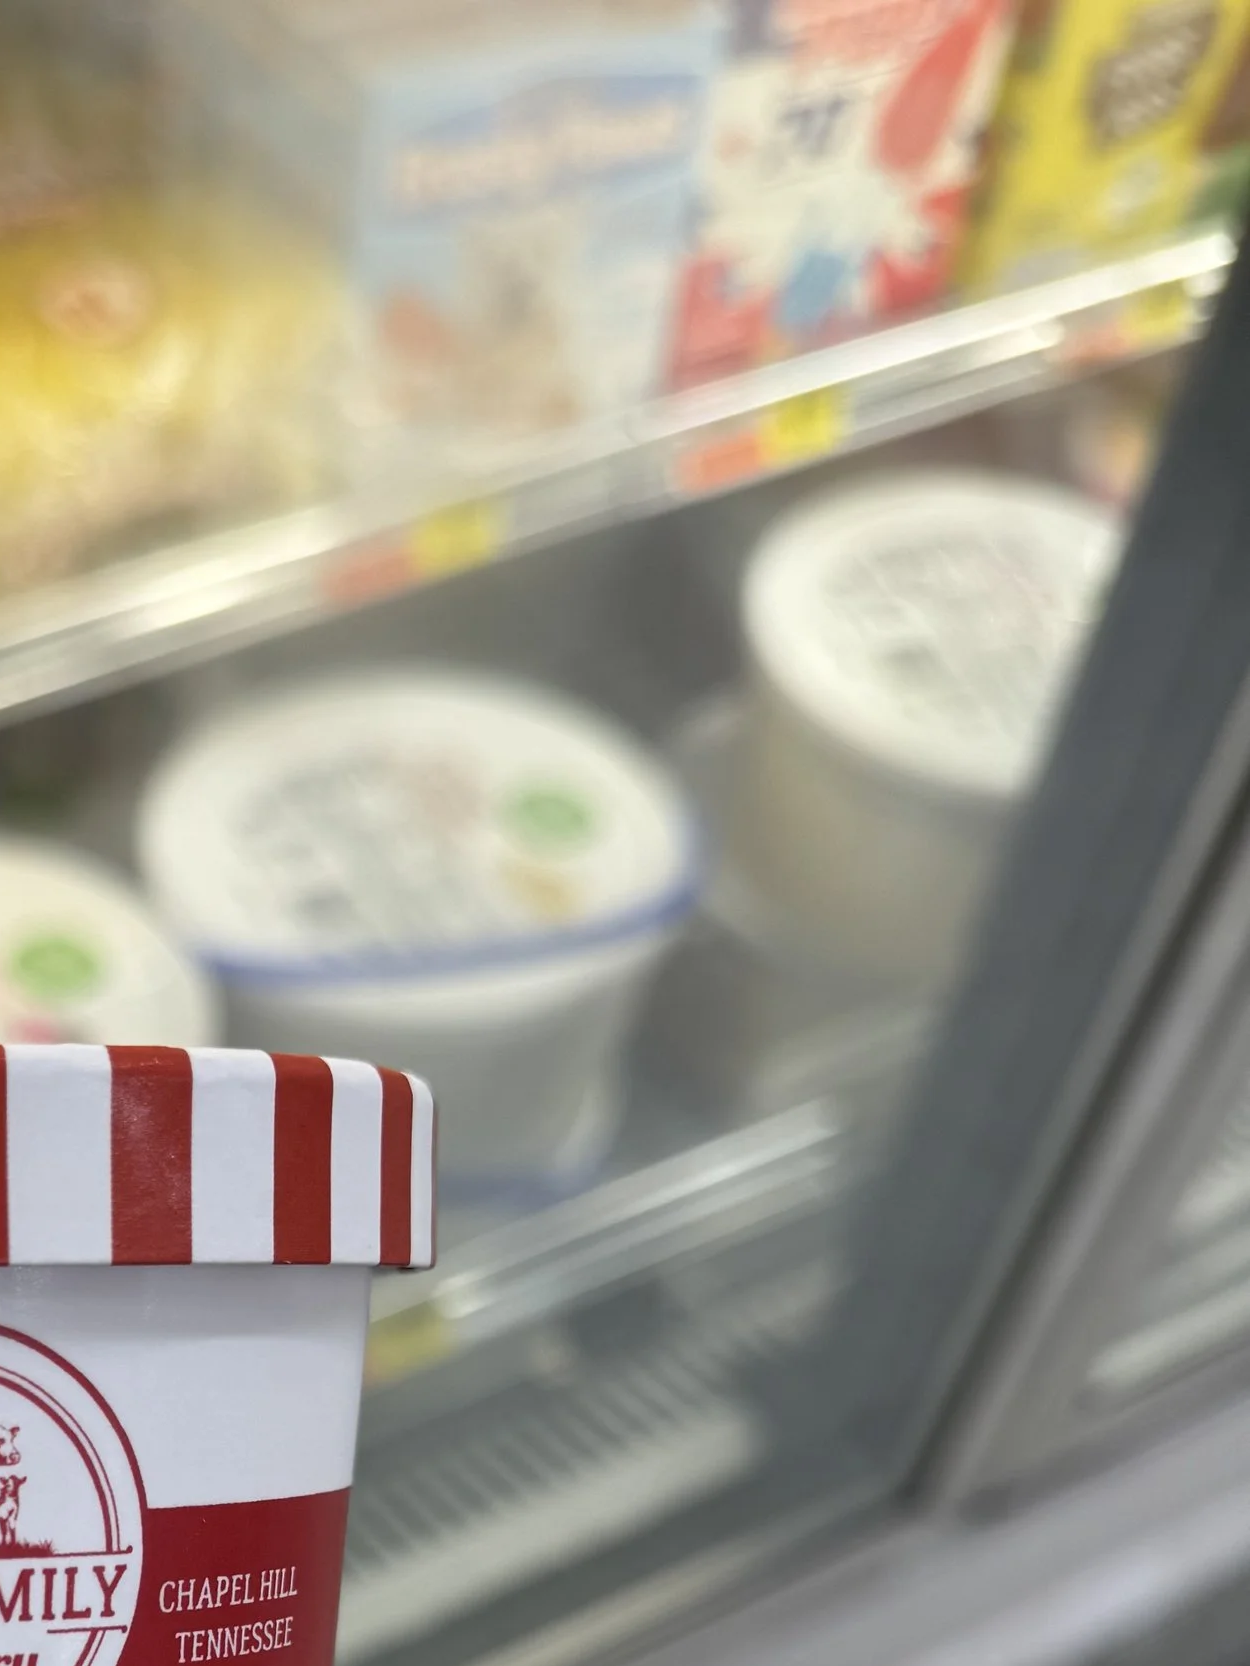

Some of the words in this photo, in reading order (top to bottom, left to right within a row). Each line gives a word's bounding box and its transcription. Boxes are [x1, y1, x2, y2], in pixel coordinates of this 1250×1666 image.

[158, 1573, 255, 1614] CHAPEL
[258, 1565, 299, 1602] HILL
[175, 1616, 295, 1664] TENNESSEE
